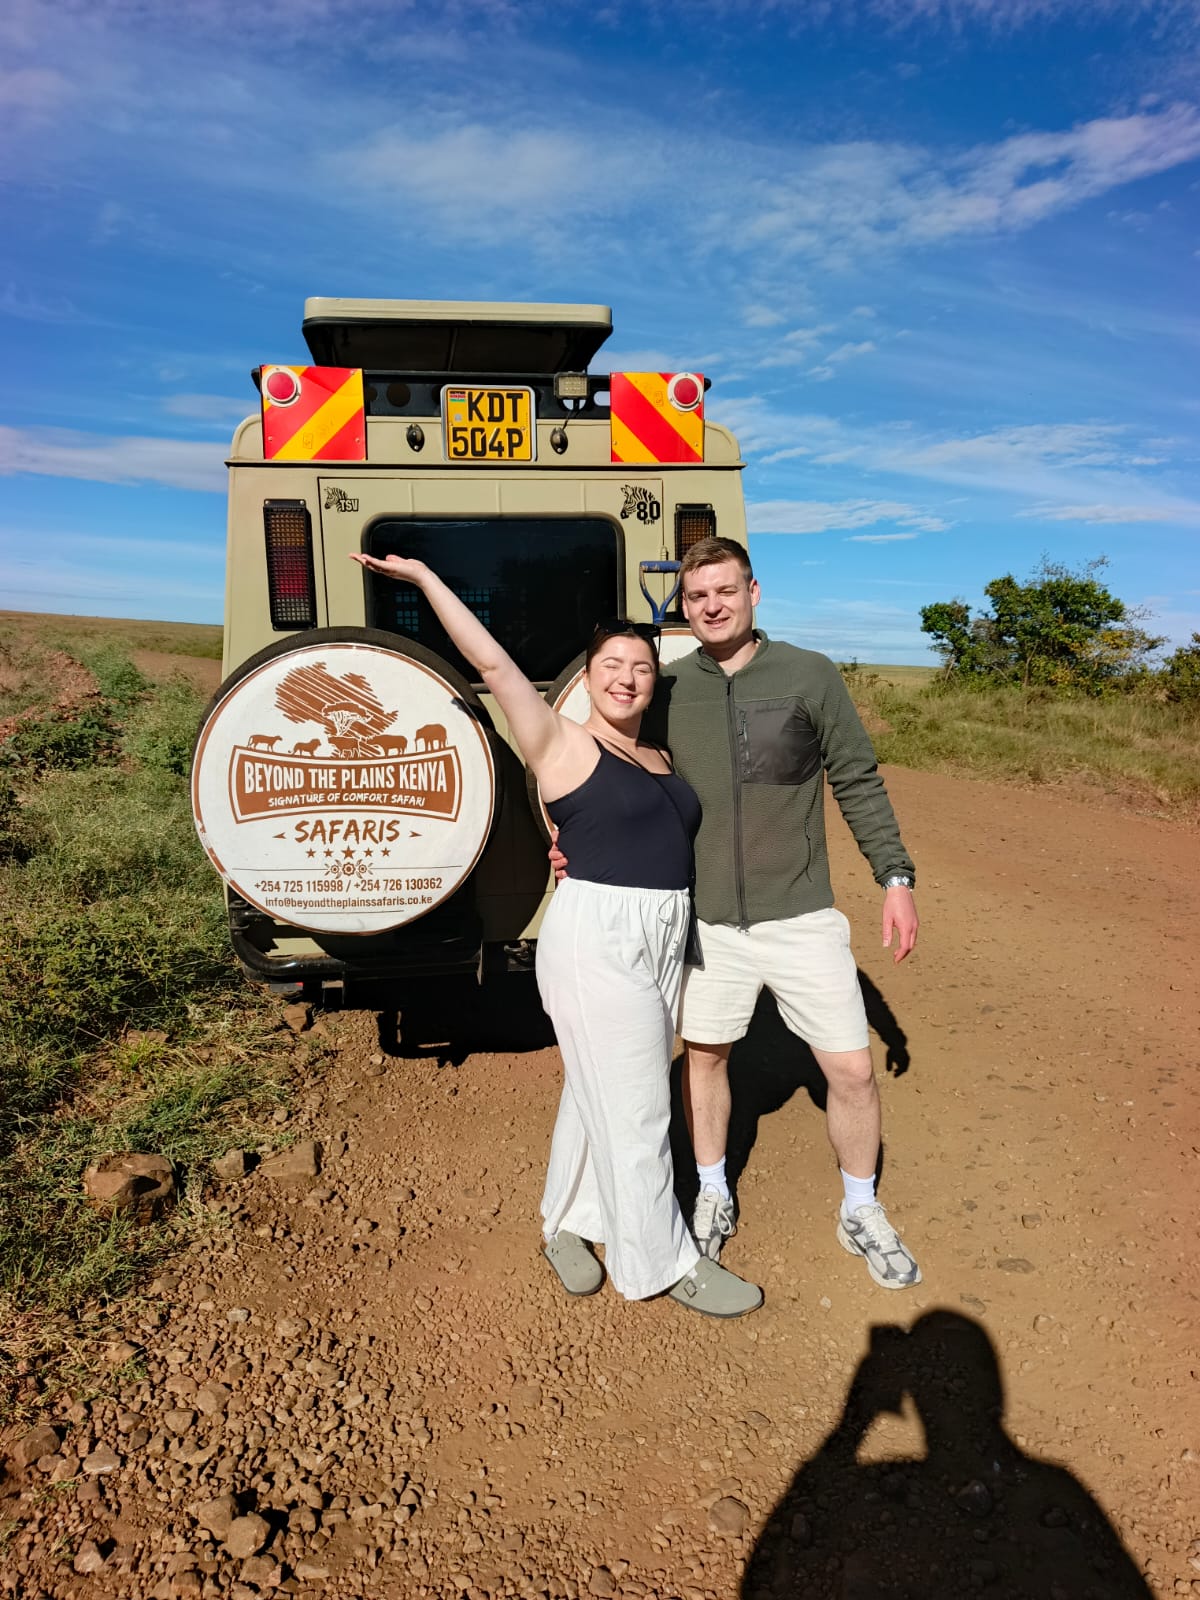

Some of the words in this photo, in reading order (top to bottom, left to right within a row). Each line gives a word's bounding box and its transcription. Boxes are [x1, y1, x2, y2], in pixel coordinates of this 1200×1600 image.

[467, 391, 523, 423] KDT
[452, 426, 524, 458] 504P
[339, 499, 359, 512] TSV
[636, 500, 661, 521] 80
[244, 761, 305, 794] BEYOND
[308, 768, 337, 789] THE
[341, 765, 395, 789] PLAINS
[399, 761, 448, 793] KENYA
[268, 793, 325, 807] SIGNATURE
[327, 792, 341, 803] OF
[342, 792, 389, 804] COMFORT
[391, 793, 426, 807] SAFARI
[294, 819, 401, 845] SAFARIS
[254, 880, 281, 893] +254
[283, 880, 304, 893] 725
[306, 879, 343, 893] 115998
[354, 879, 381, 892] +254
[383, 879, 402, 892] 726
[405, 877, 443, 891] 130362
